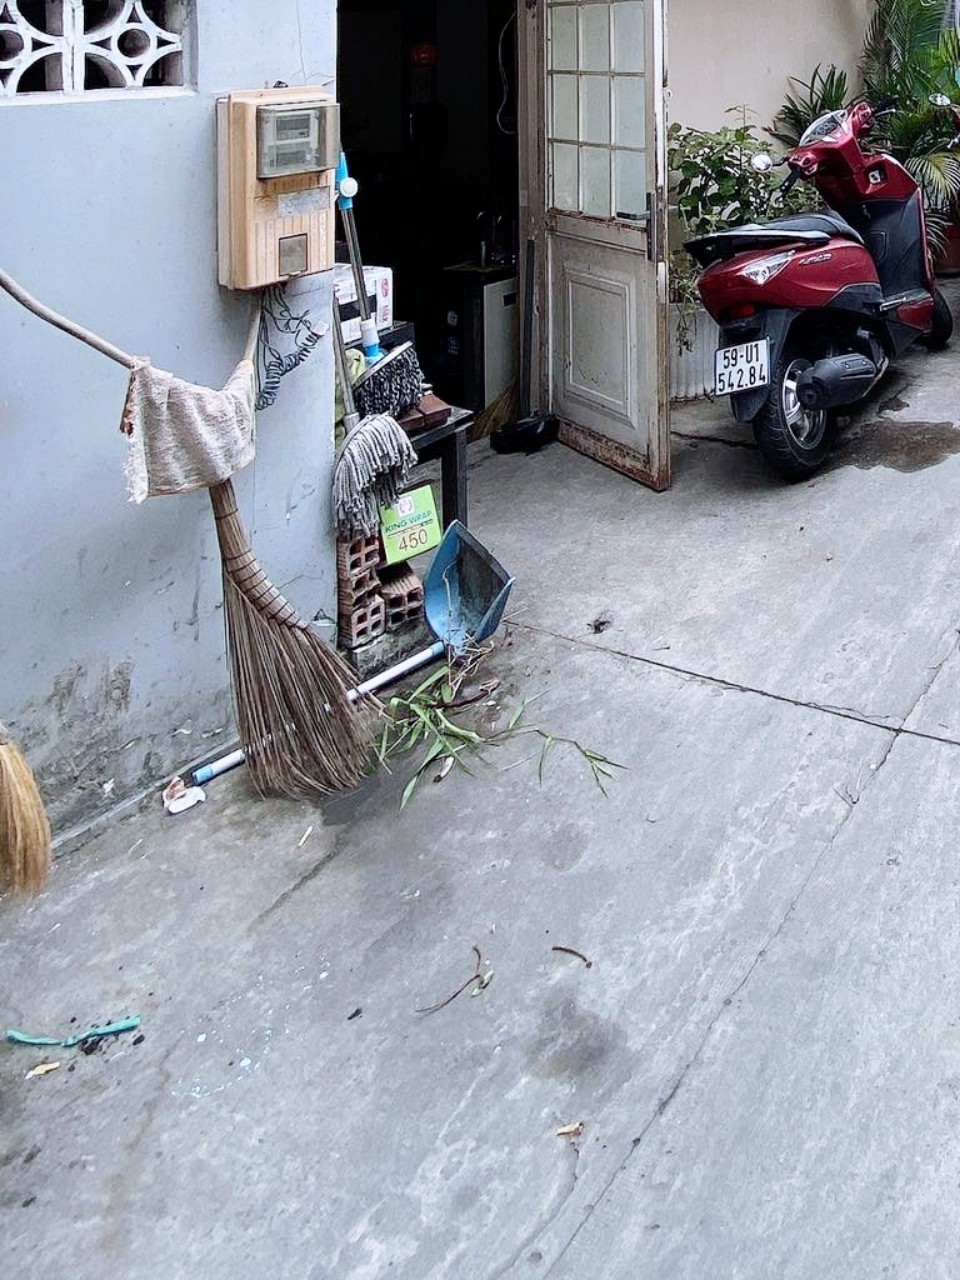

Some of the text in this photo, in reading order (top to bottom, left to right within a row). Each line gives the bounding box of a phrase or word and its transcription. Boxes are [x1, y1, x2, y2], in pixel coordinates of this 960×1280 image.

[723, 343, 760, 369] 59-U1
[718, 363, 766, 392] 542.84
[385, 519, 407, 534] KING
[398, 528, 429, 551] 450
